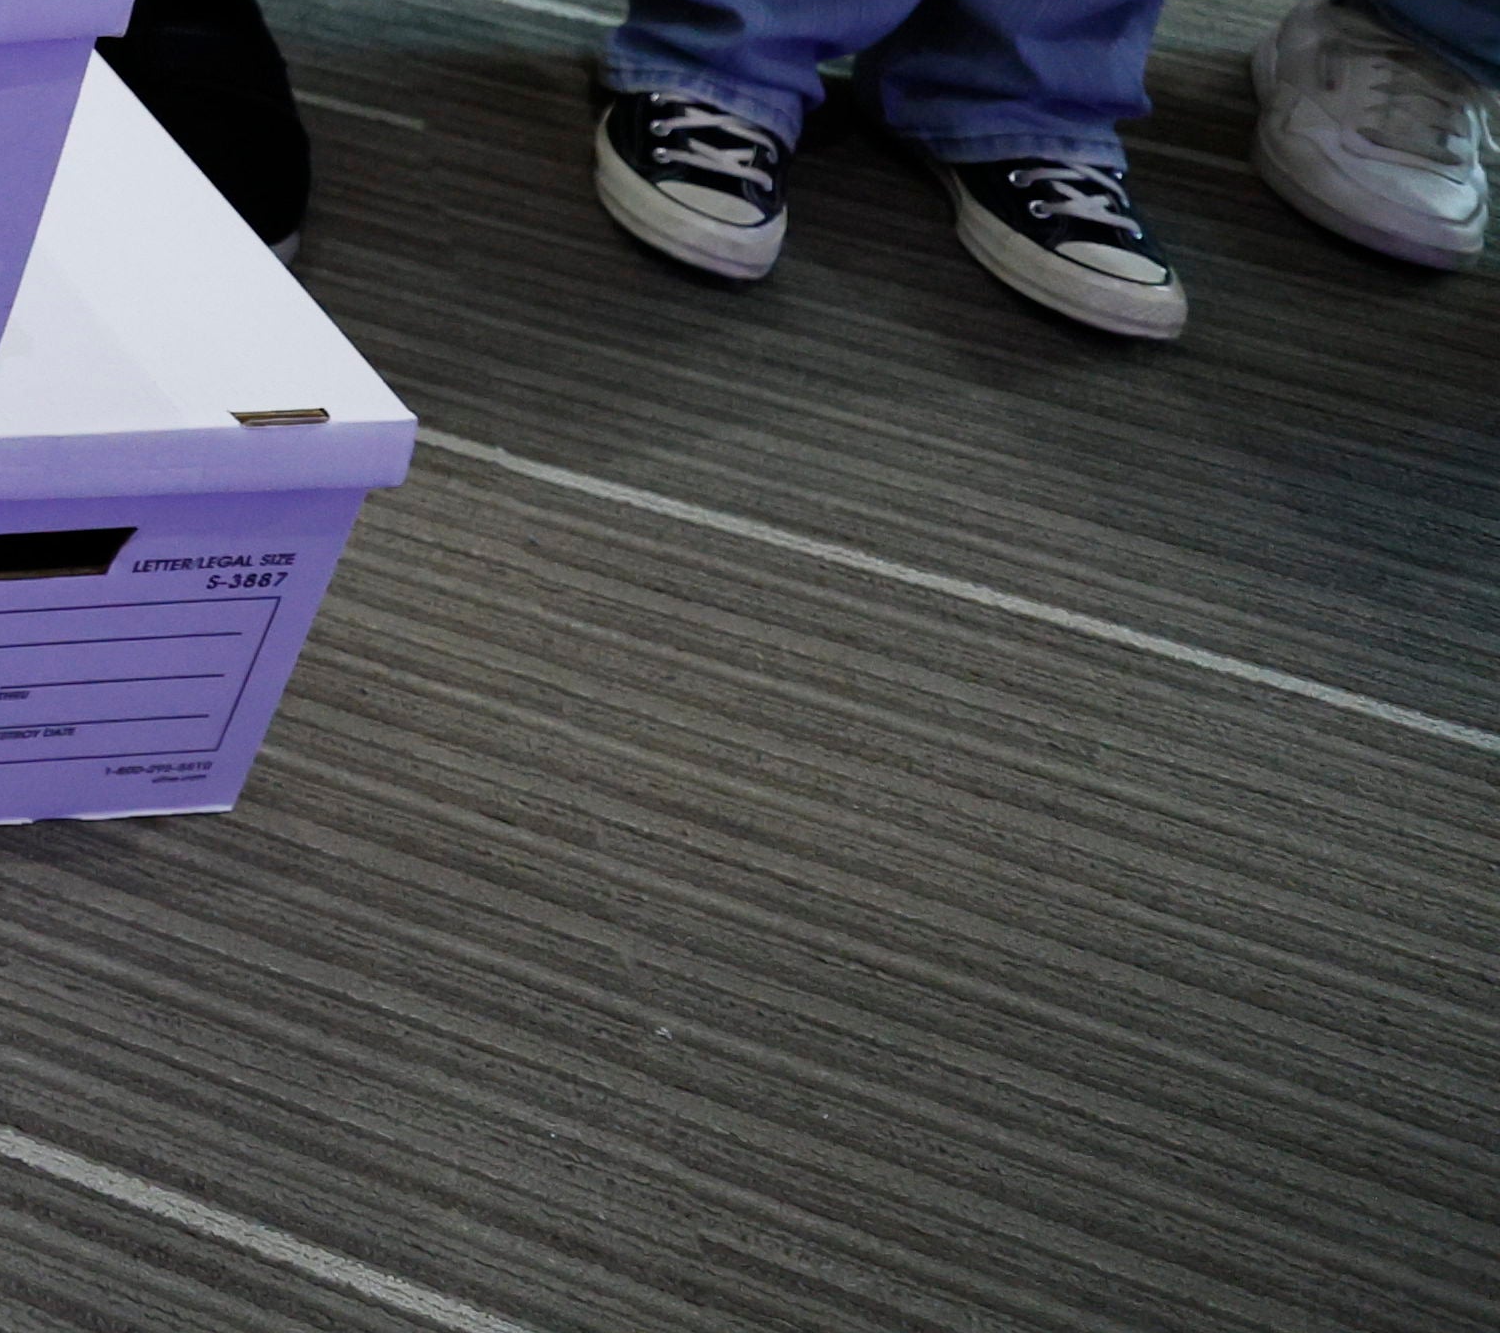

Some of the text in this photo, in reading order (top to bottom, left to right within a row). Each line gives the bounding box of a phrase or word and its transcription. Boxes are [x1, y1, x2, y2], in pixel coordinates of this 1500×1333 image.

[132, 552, 296, 574] LETTER/LEGAL SIZE
[206, 571, 289, 590] S-3887
